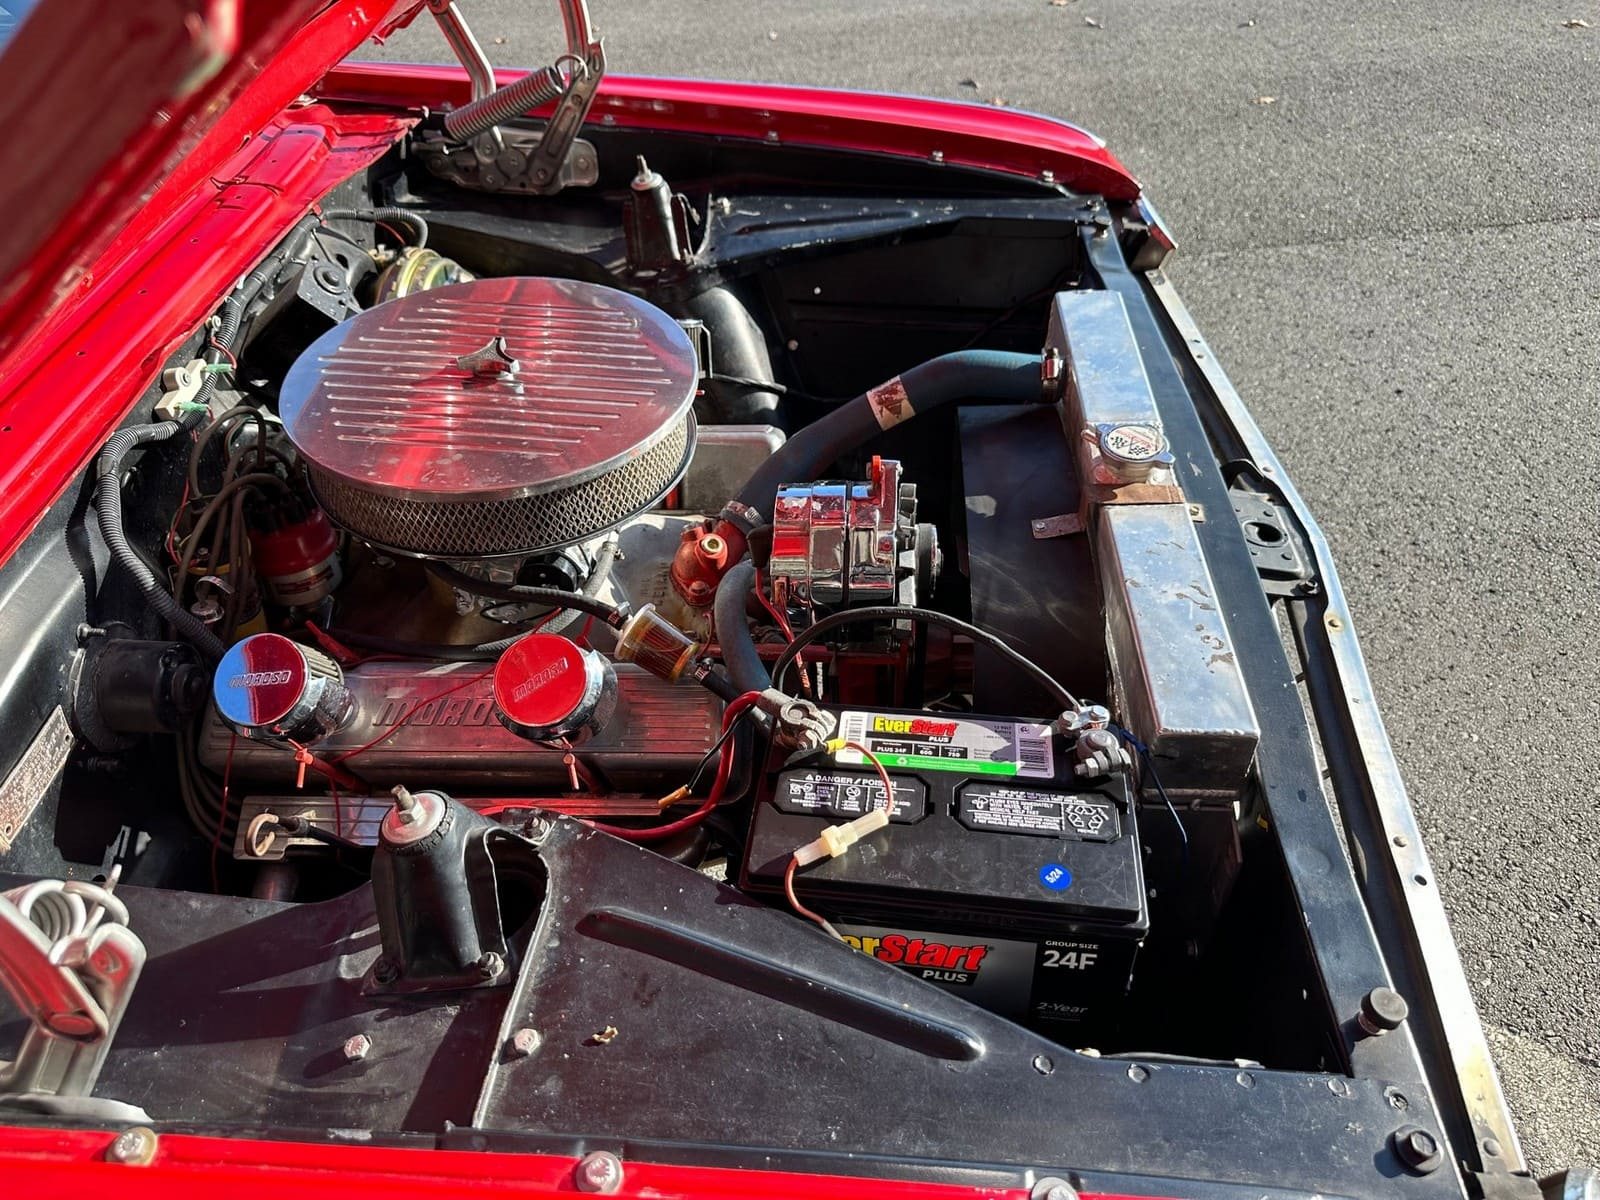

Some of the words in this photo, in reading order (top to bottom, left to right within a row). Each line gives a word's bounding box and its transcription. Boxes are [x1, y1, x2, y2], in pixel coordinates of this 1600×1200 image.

[229, 669, 292, 688] MOROSO
[513, 656, 569, 703] MOROSO
[371, 697, 503, 727] MORO
[873, 716, 959, 737] EverStart
[815, 774, 853, 784] DANGER
[862, 779, 897, 788] POISN
[1044, 867, 1064, 884] 5/24
[842, 934, 988, 972] rStart
[1045, 940, 1078, 949] GROUP
[1078, 942, 1099, 950] SIZE
[1042, 950, 1098, 970] 24F
[922, 969, 969, 983] PLUS
[1036, 1001, 1089, 1014] 2-Year
